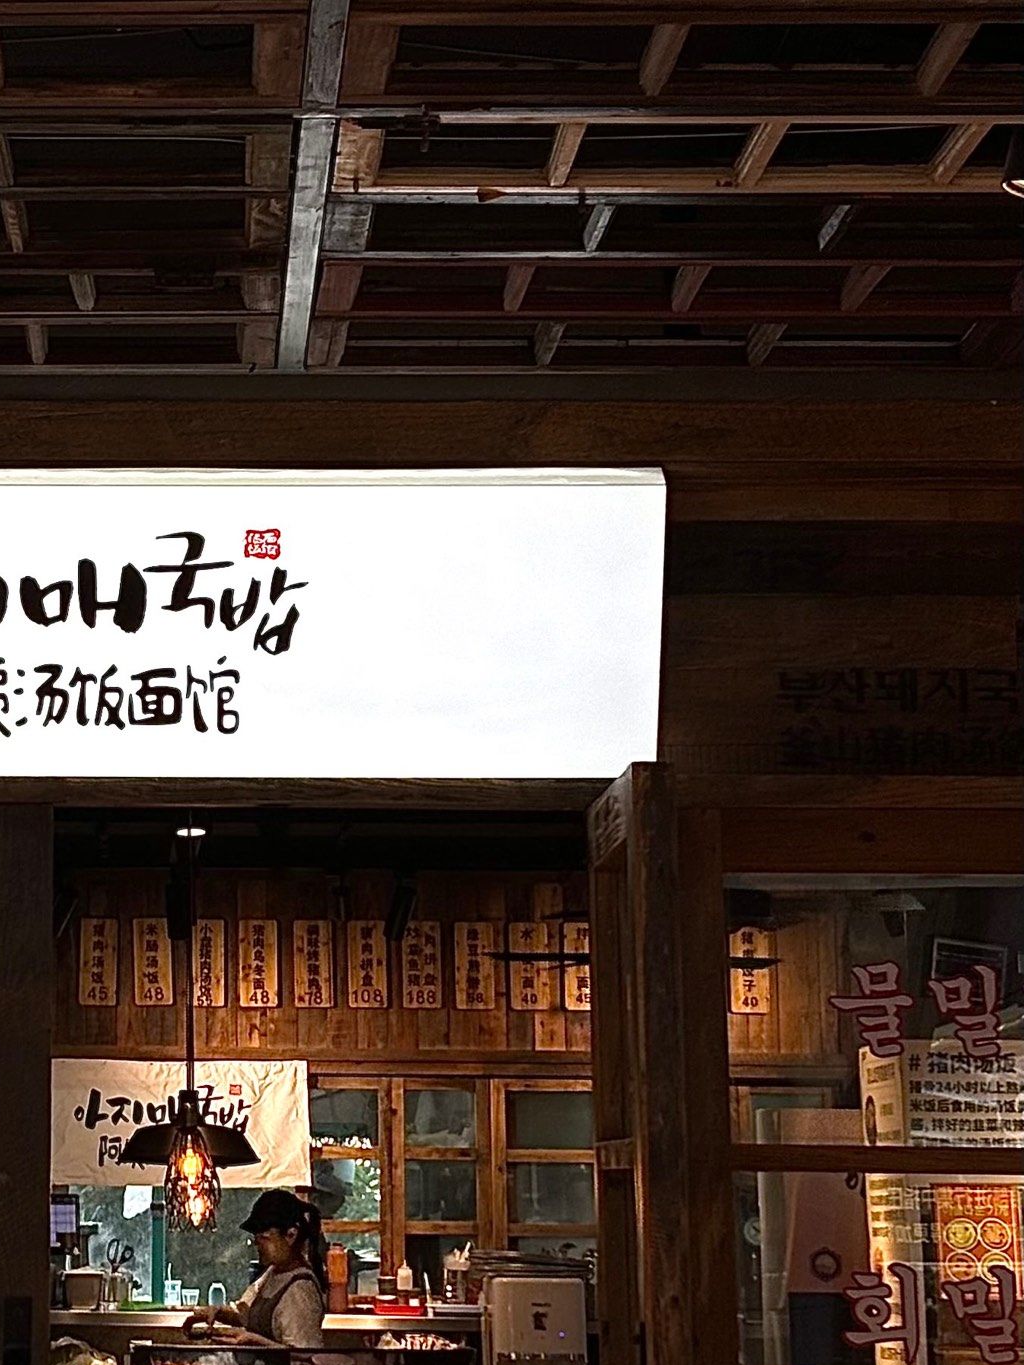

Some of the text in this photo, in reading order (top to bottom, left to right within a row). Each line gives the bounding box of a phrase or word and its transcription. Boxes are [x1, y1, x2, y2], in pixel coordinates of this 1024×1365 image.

[87, 985, 108, 1001] 45
[144, 986, 165, 1002] 48
[249, 990, 270, 1005] 48
[305, 991, 323, 1006] 78
[352, 989, 383, 1004] 108
[406, 989, 436, 1005] 188
[742, 996, 759, 1007] 40
